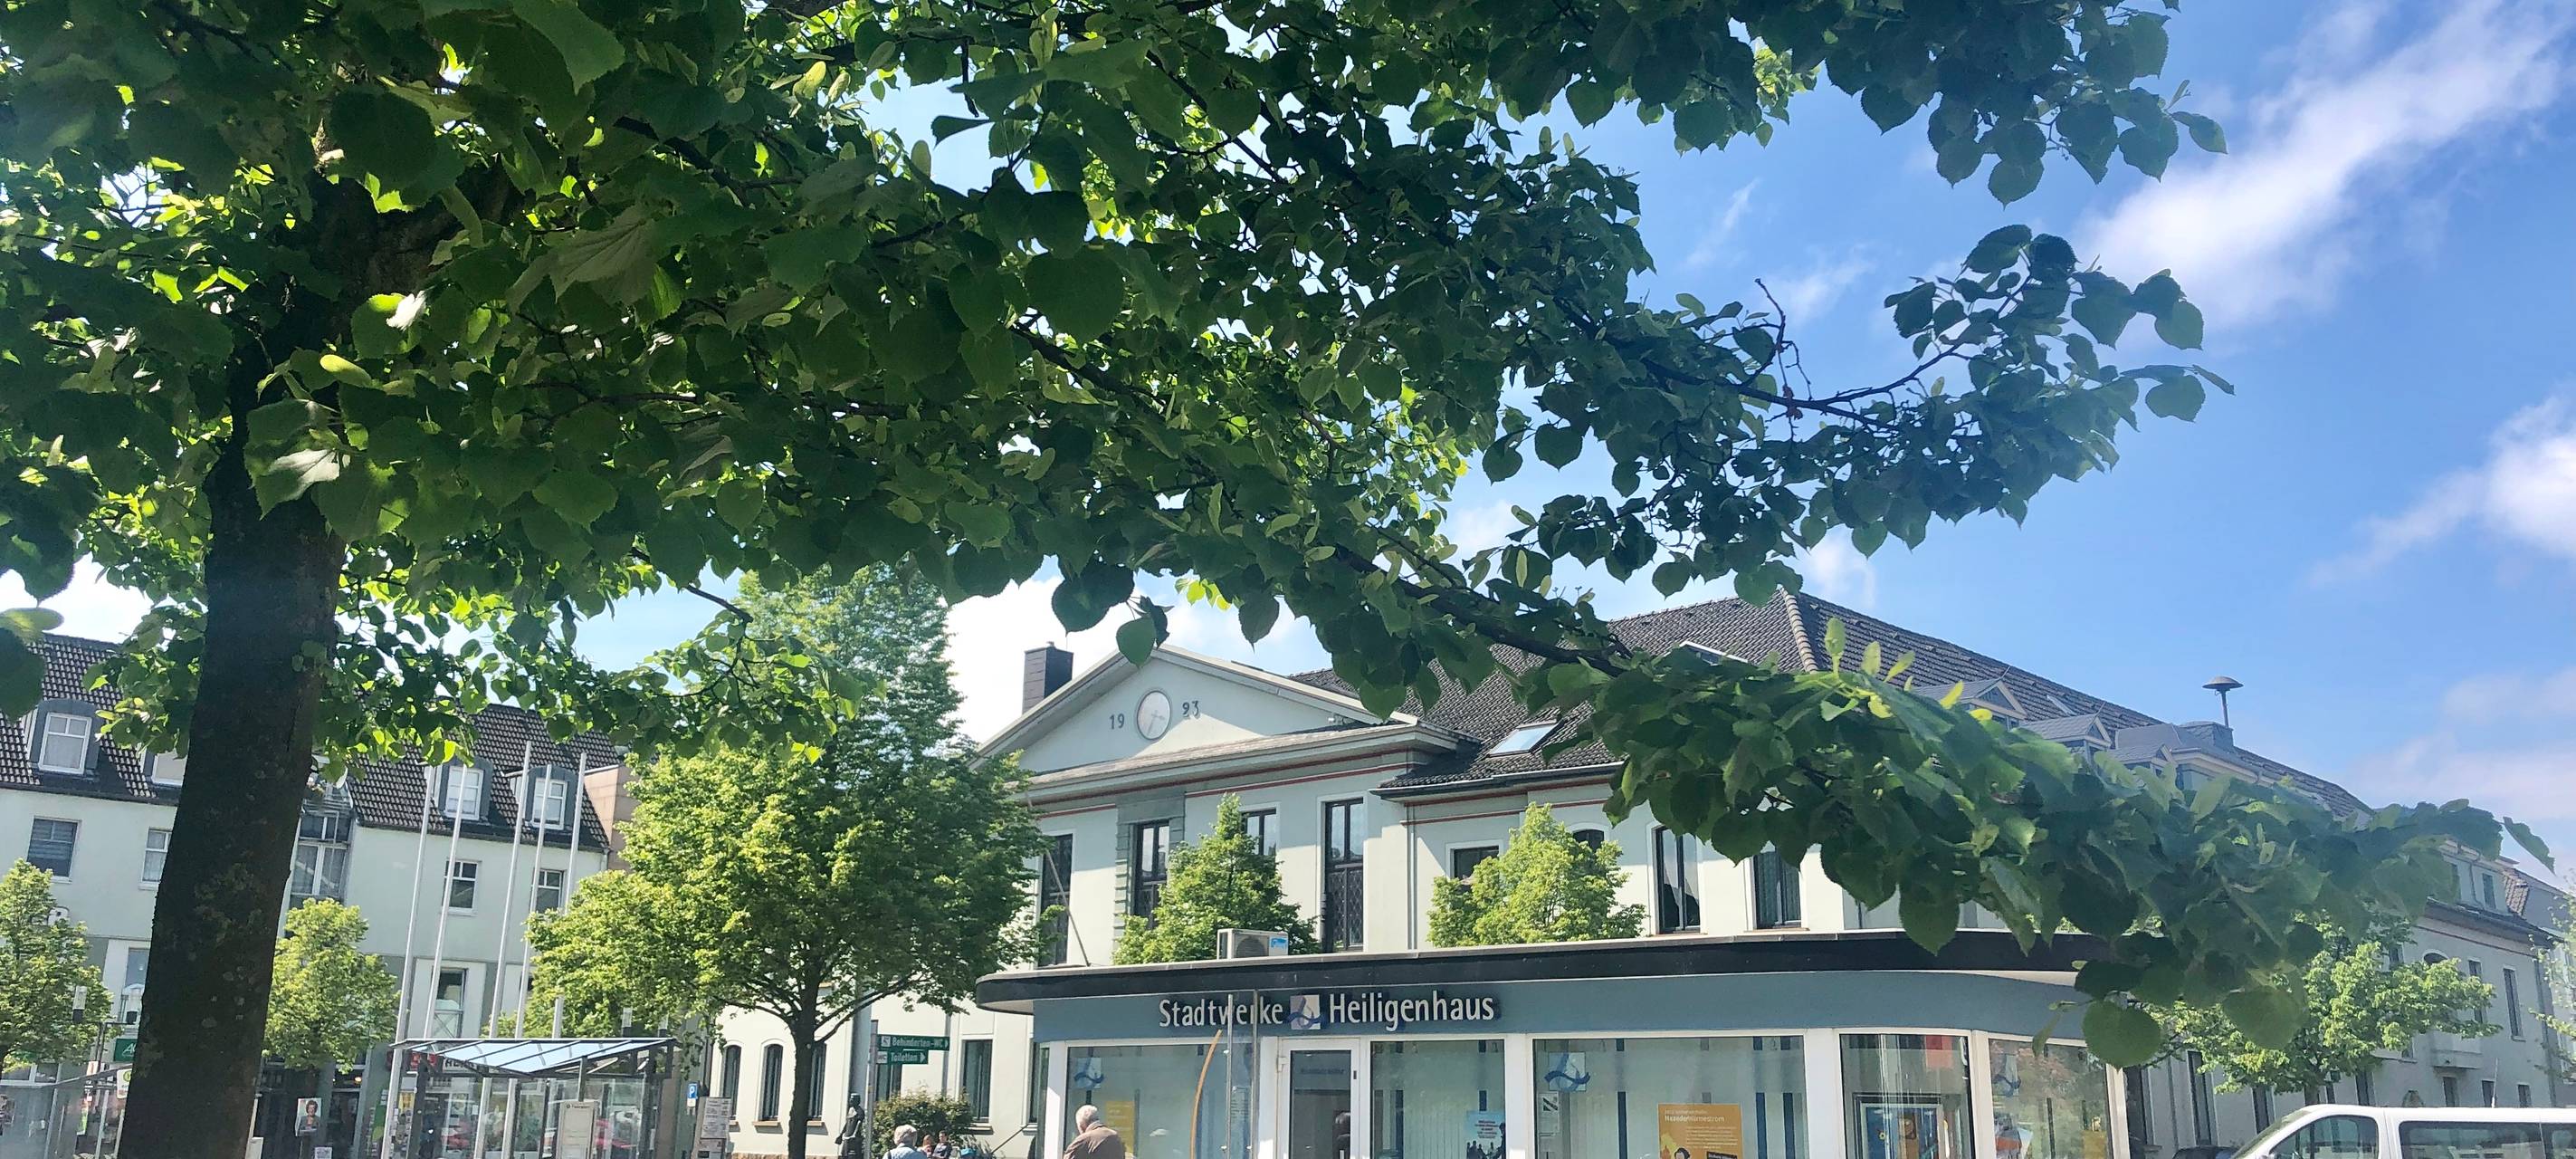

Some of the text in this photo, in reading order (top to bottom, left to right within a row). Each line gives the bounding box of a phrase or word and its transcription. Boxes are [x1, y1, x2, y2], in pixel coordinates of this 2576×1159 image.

[1110, 713, 1125, 730] 19
[1329, 990, 1494, 1032] Heiligenhaus
[892, 1036, 943, 1048] Behinderten-WC
[891, 1052, 918, 1062] Toiletten
[689, 1086, 695, 1098] P
